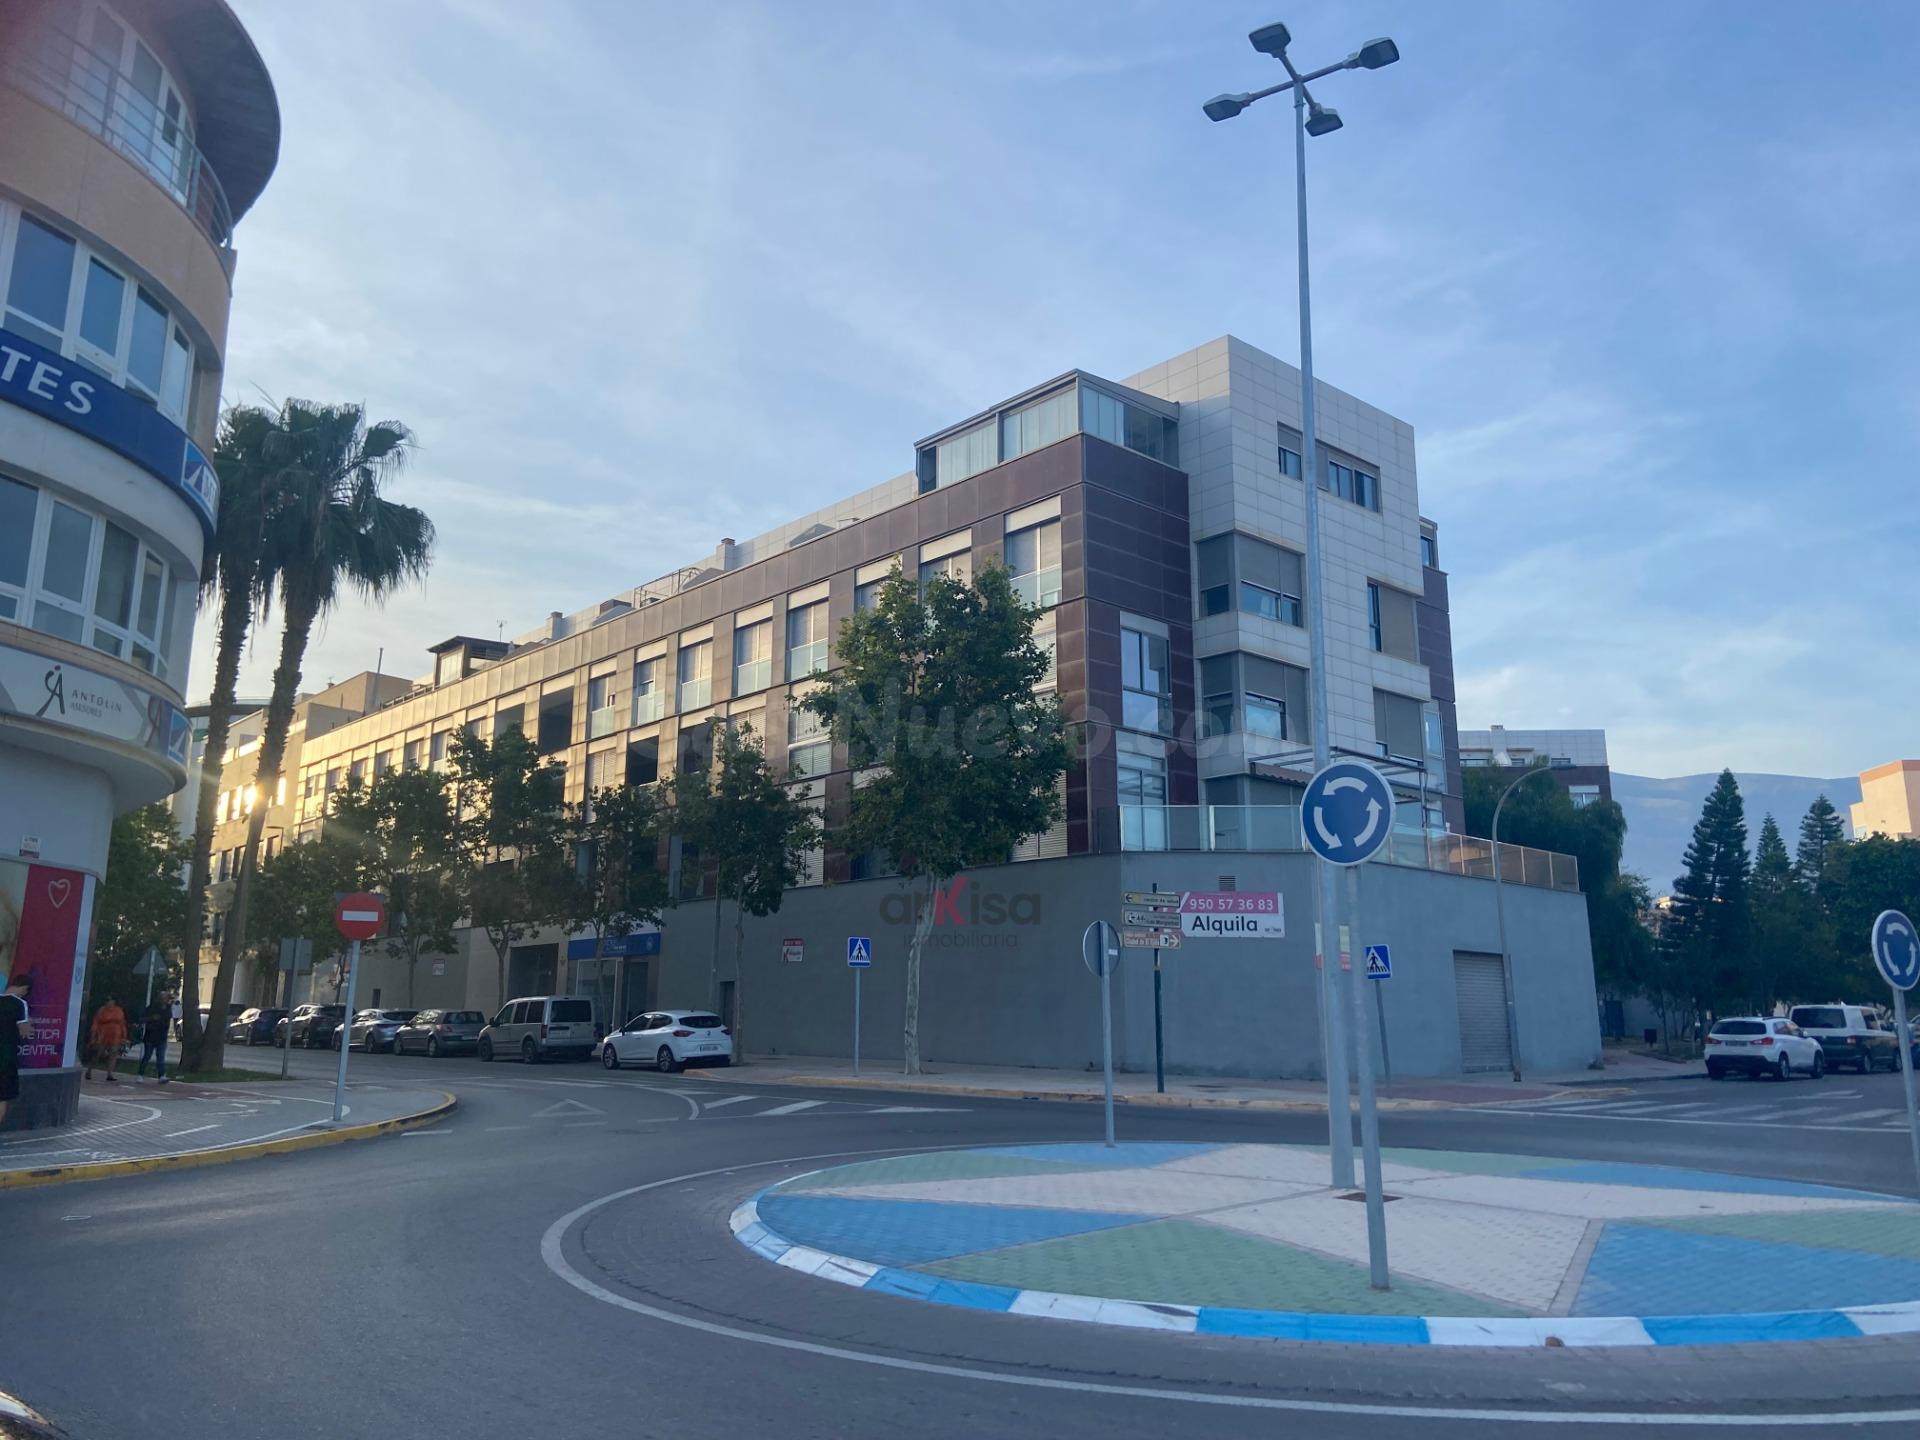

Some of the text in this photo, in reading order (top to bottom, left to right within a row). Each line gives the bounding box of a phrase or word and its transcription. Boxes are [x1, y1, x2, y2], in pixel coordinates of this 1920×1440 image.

[1190, 898, 1274, 911] 950 57 36 83
[1191, 915, 1258, 935] Alquila
